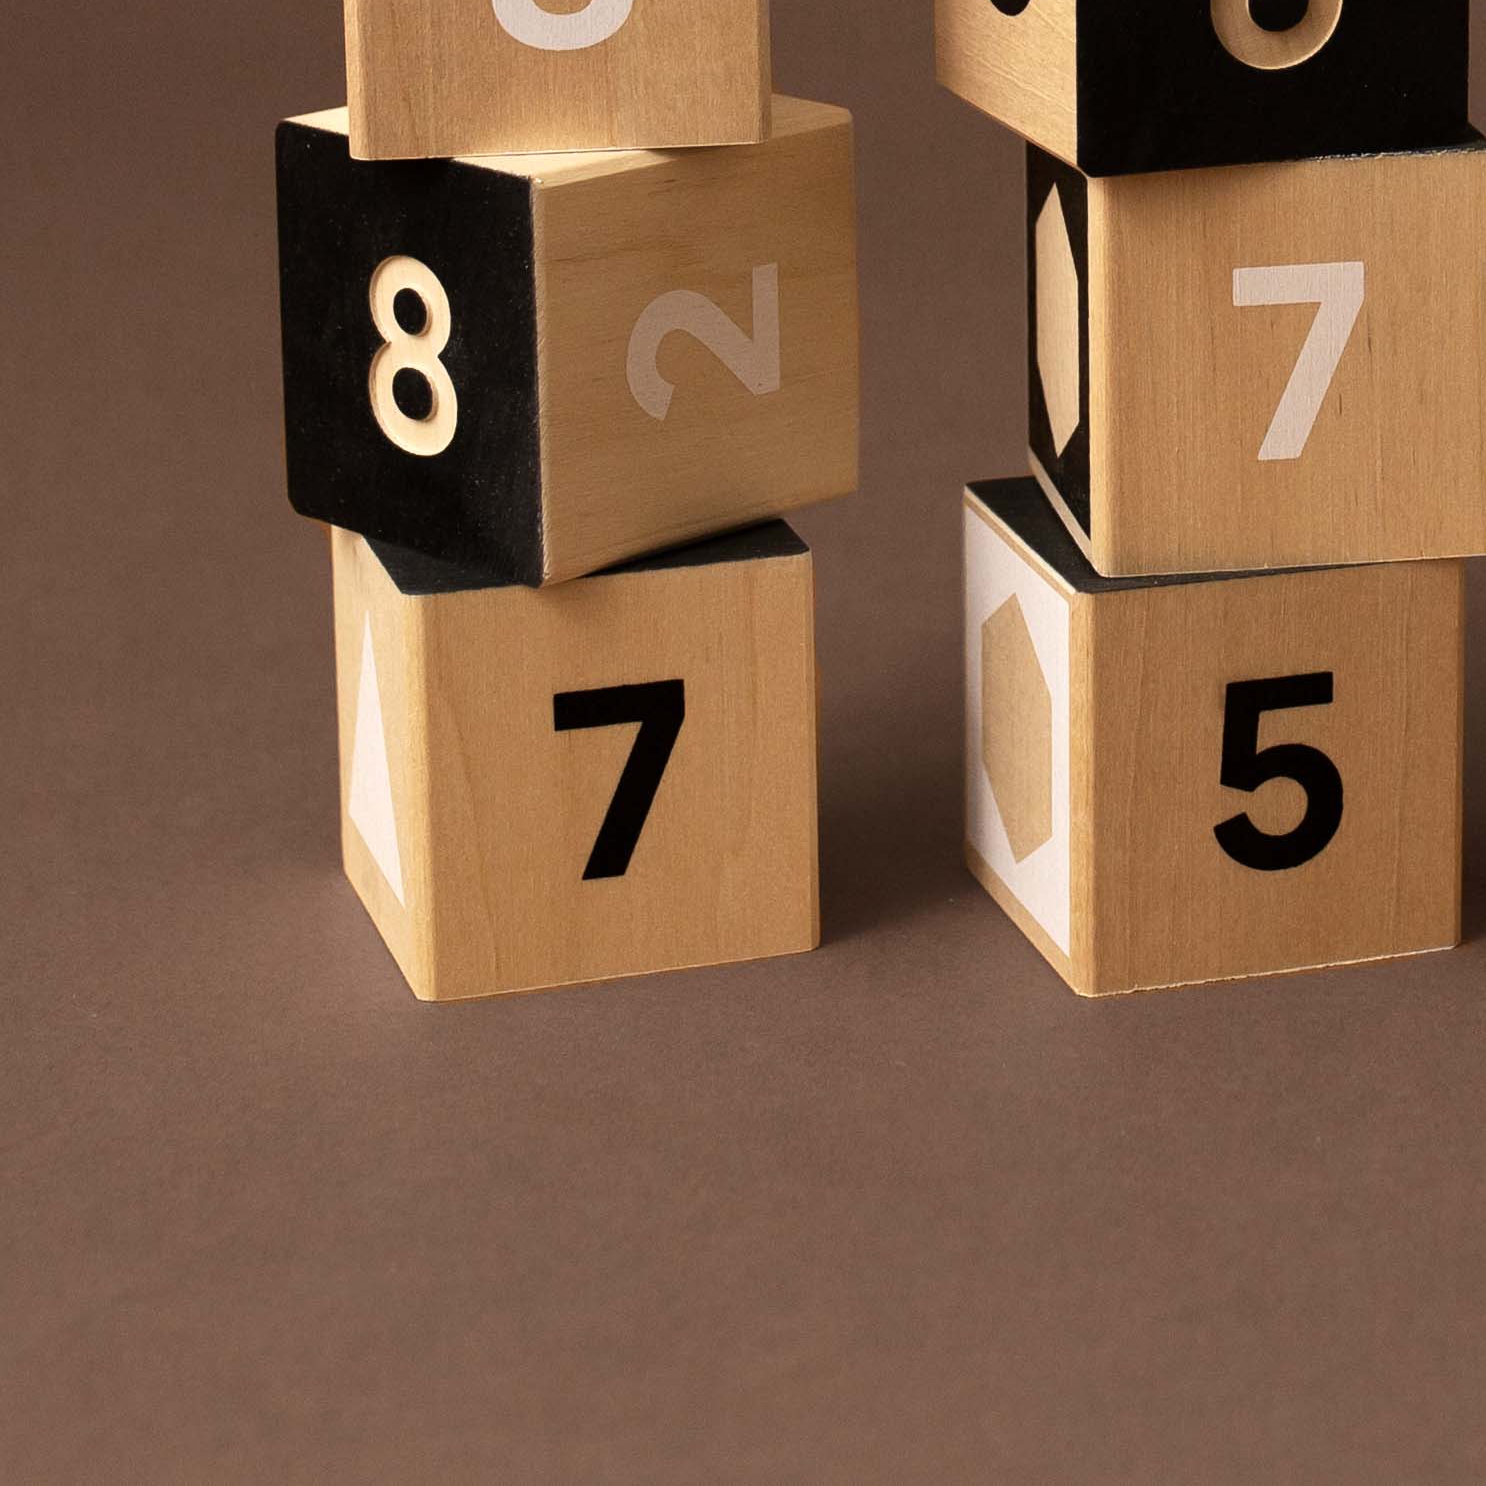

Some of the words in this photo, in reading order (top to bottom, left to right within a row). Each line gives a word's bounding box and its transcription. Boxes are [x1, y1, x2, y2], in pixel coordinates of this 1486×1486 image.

[368, 254, 459, 457] 8
[626, 262, 782, 422] 2
[1232, 260, 1365, 462] 7
[552, 678, 686, 882] 7
[1213, 671, 1345, 873] 5
